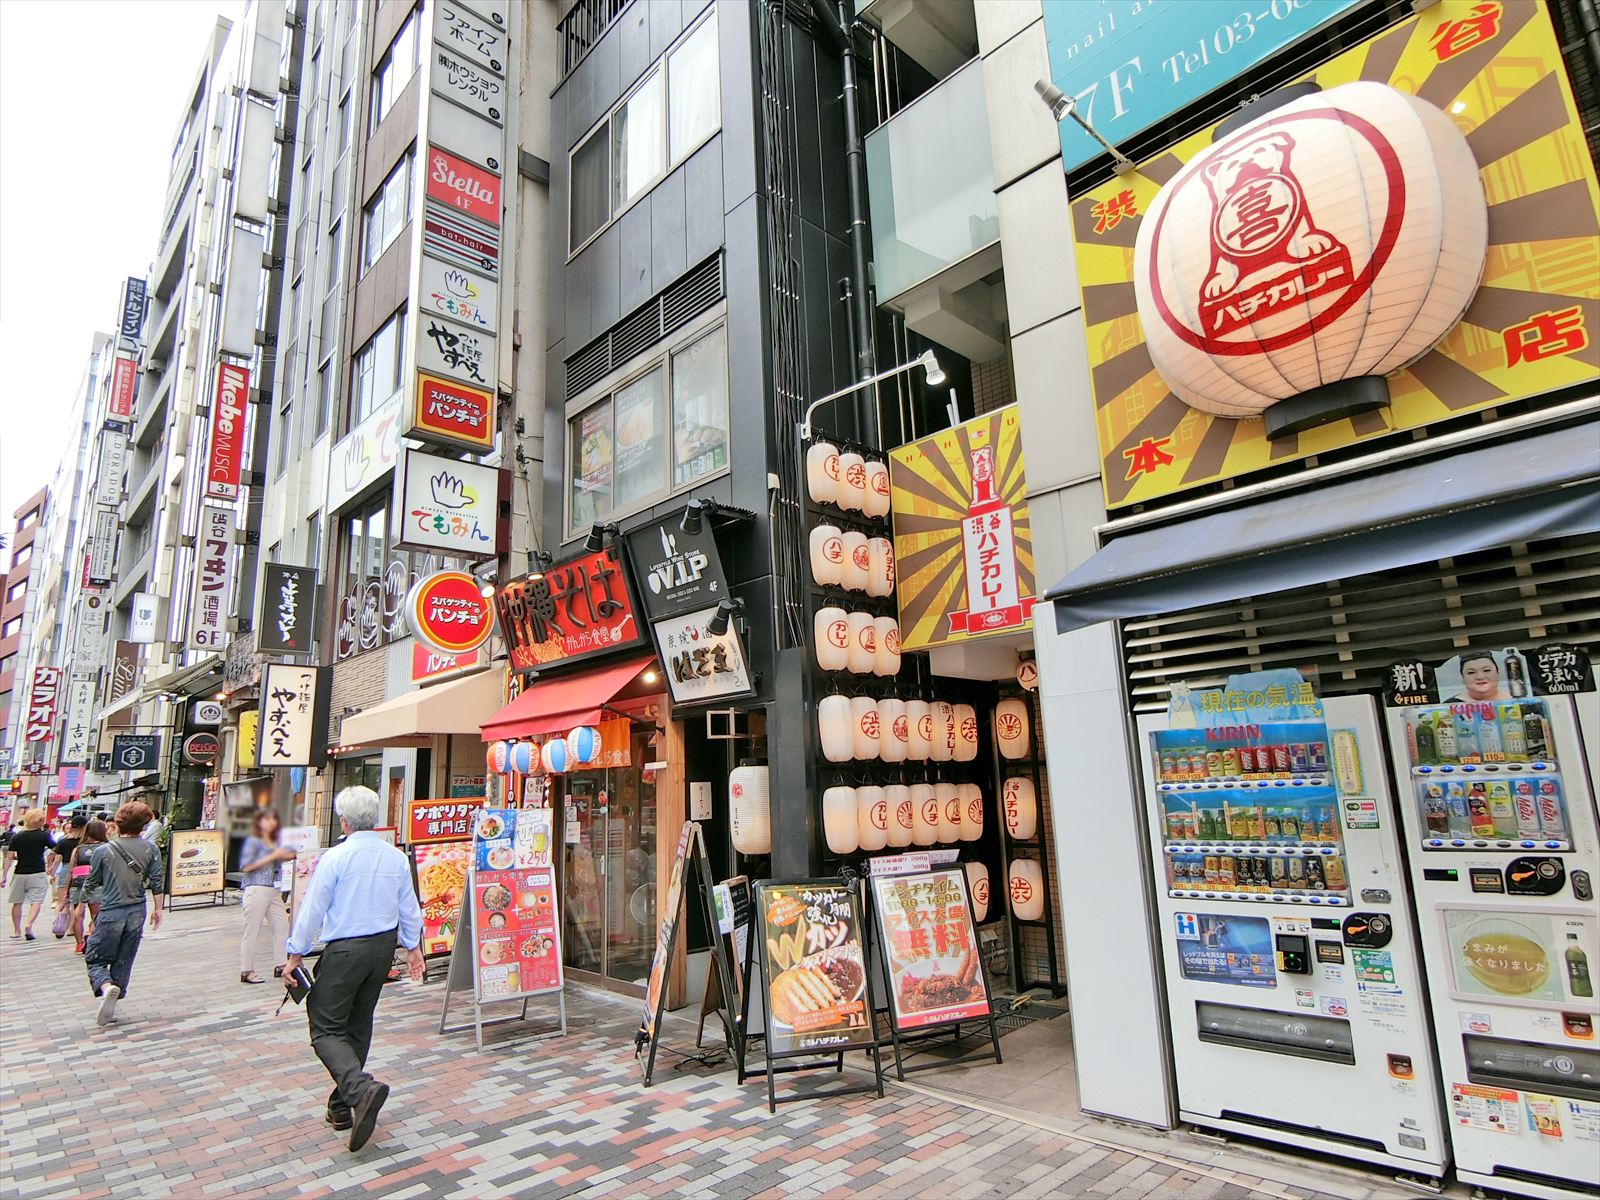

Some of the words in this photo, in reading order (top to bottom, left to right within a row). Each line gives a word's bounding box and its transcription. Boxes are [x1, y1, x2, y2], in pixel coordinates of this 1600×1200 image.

[442, 7, 500, 46] ファイブ
[1066, 12, 1116, 60] nail
[1428, 3, 1502, 64] 谷
[450, 26, 491, 57] ホーム
[447, 72, 489, 102] レンタル
[1075, 56, 1142, 135] 7F
[1162, 39, 1211, 86] Tel
[432, 162, 495, 205] Stella
[1090, 190, 1137, 234] 渋
[1226, 180, 1289, 249] 喜
[431, 293, 487, 324] てもみん
[1213, 266, 1347, 331] ハチカレー
[123, 292, 142, 335] ドルフィン
[1500, 306, 1588, 368] 店
[383, 395, 402, 414] Alway
[428, 402, 478, 427] パンチョ
[906, 438, 962, 462] HACHI
[1122, 436, 1175, 480] 本
[847, 465, 866, 488] 渋
[217, 484, 230, 494] 3F
[212, 513, 228, 538] 渋谷
[411, 510, 490, 541] てもみん
[971, 512, 1001, 535] 渋谷
[830, 541, 843, 559] ハチ
[978, 532, 1002, 608] ハチカレー
[499, 547, 624, 650] 沖縄そば
[709, 580, 718, 593] 4F
[202, 595, 220, 627] 酒場
[430, 608, 479, 625] パンチョ
[79, 612, 97, 661] ほぐし家
[195, 630, 221, 645] 6F
[835, 623, 847, 647] カレー
[1538, 652, 1577, 668] どデカ
[1541, 667, 1584, 683] うまい。
[1200, 682, 1317, 714] 現在の気温
[1404, 694, 1429, 704] FIRE
[1549, 682, 1579, 693] 600ml
[27, 668, 58, 742] カラオケ
[1450, 703, 1493, 715] KIRIN
[269, 686, 297, 758] やすべえ
[863, 712, 880, 738] 渋
[963, 719, 977, 742] 渋
[1205, 724, 1261, 743] KIRIN
[414, 804, 480, 820] ナポリタン
[878, 804, 887, 828] カレー
[928, 803, 938, 822] ハチ
[1005, 791, 1018, 835] ハチカレー
[428, 820, 466, 834] 専門店
[518, 850, 548, 865] ¥250
[802, 889, 848, 905] カツカレー
[883, 879, 960, 900] ランチタイム
[1011, 879, 1029, 901] 渋
[806, 904, 837, 925] 強化
[888, 905, 966, 928] ライス大盛
[766, 914, 806, 971] W
[806, 920, 848, 954] カツ
[892, 921, 970, 960] 無料
[1461, 942, 1507, 954] うまみが
[1461, 955, 1553, 974] 強くなりました。
